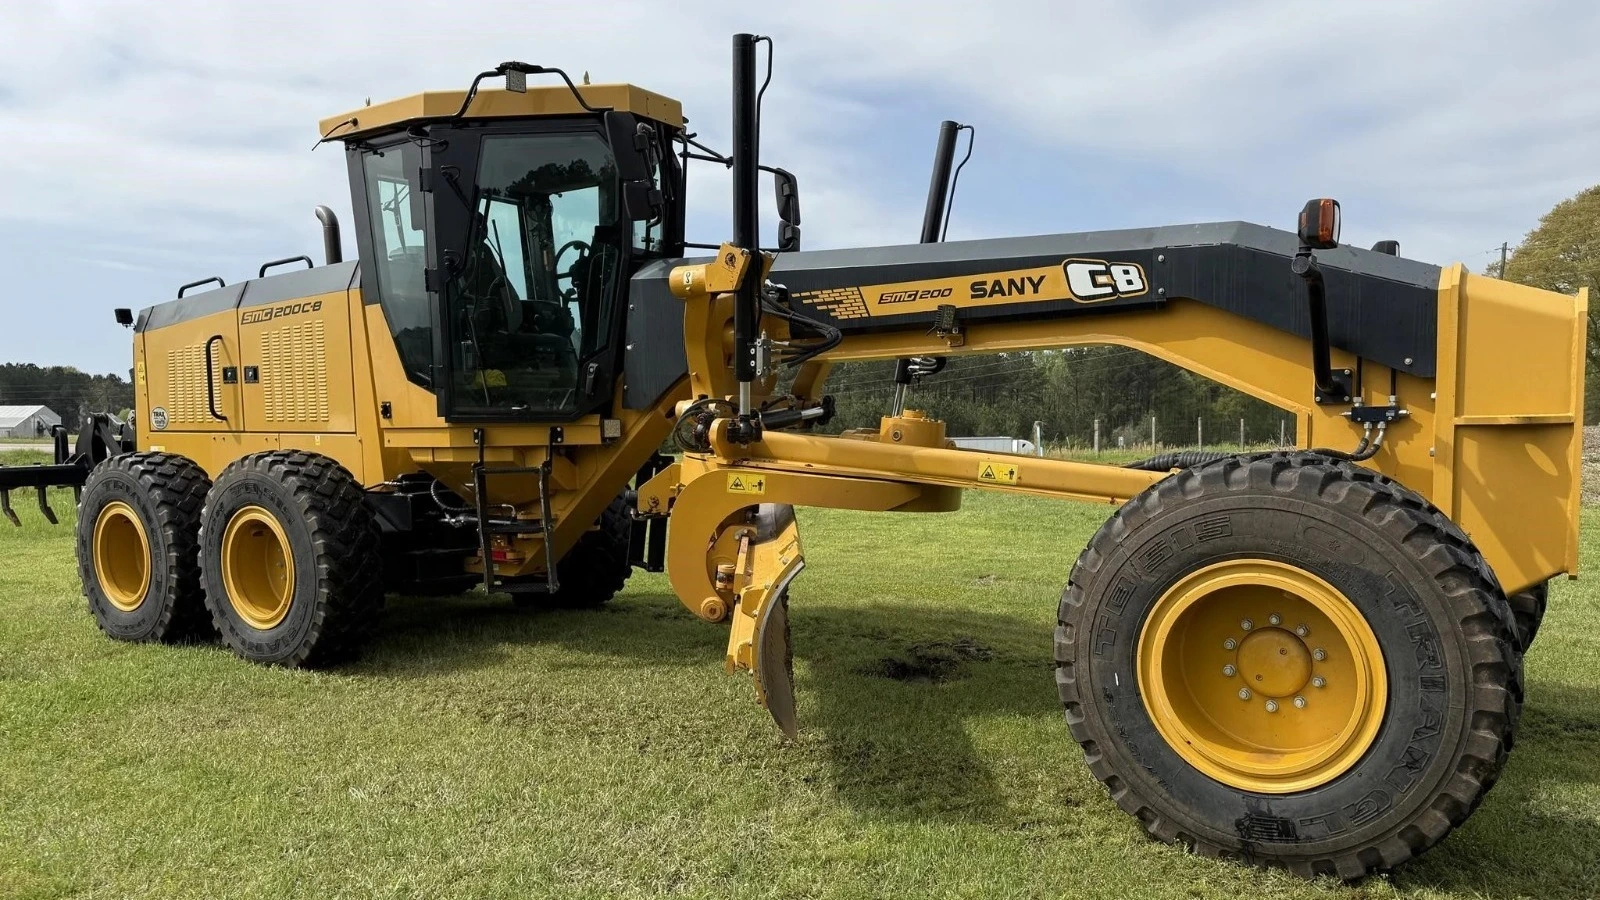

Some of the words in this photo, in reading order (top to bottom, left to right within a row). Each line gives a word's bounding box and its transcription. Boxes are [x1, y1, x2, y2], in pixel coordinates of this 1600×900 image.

[878, 290, 919, 304] SMG
[919, 288, 953, 299] 200
[970, 275, 1046, 300] SANY
